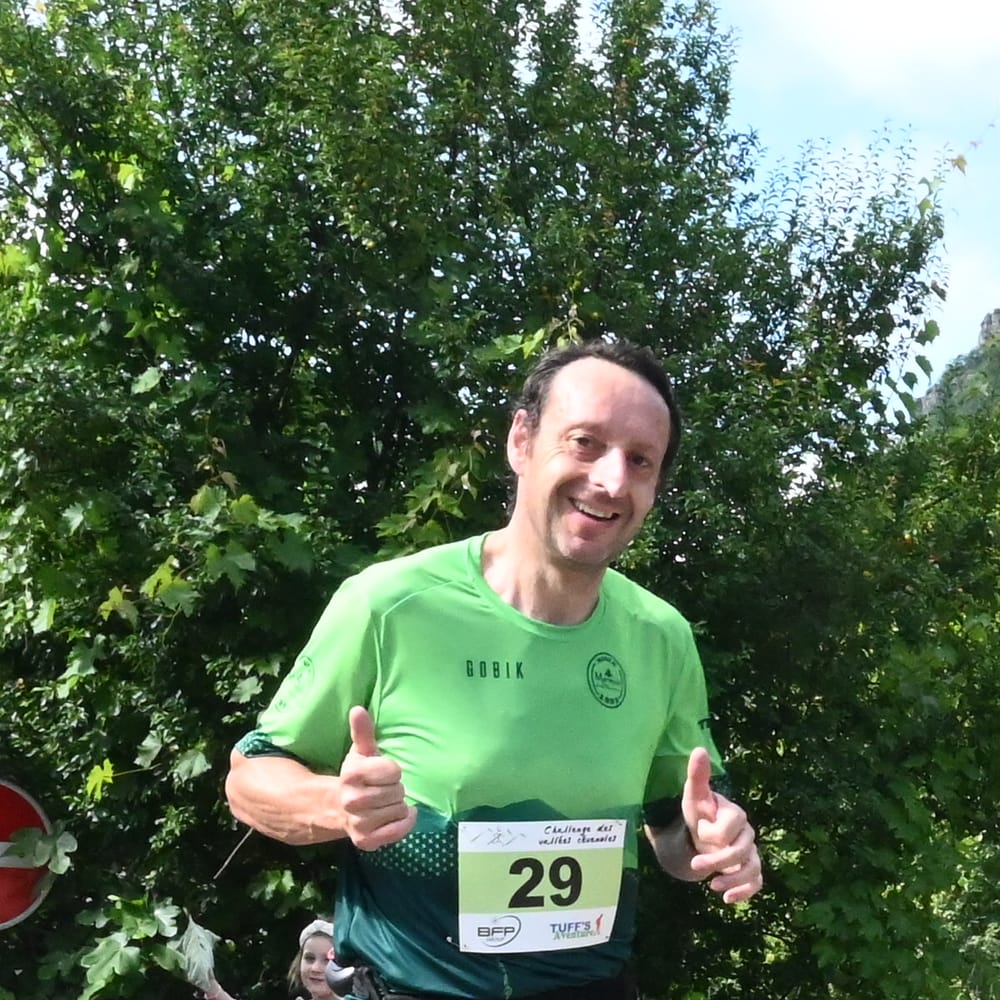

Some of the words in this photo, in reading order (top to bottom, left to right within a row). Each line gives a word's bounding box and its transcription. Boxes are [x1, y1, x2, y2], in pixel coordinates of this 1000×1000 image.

[466, 660, 524, 679] GOBIK
[544, 825, 591, 836] Challenge
[597, 824, 613, 832] des
[508, 856, 583, 908] 29
[477, 926, 516, 937] BFP
[550, 921, 591, 933] TUFF'S
